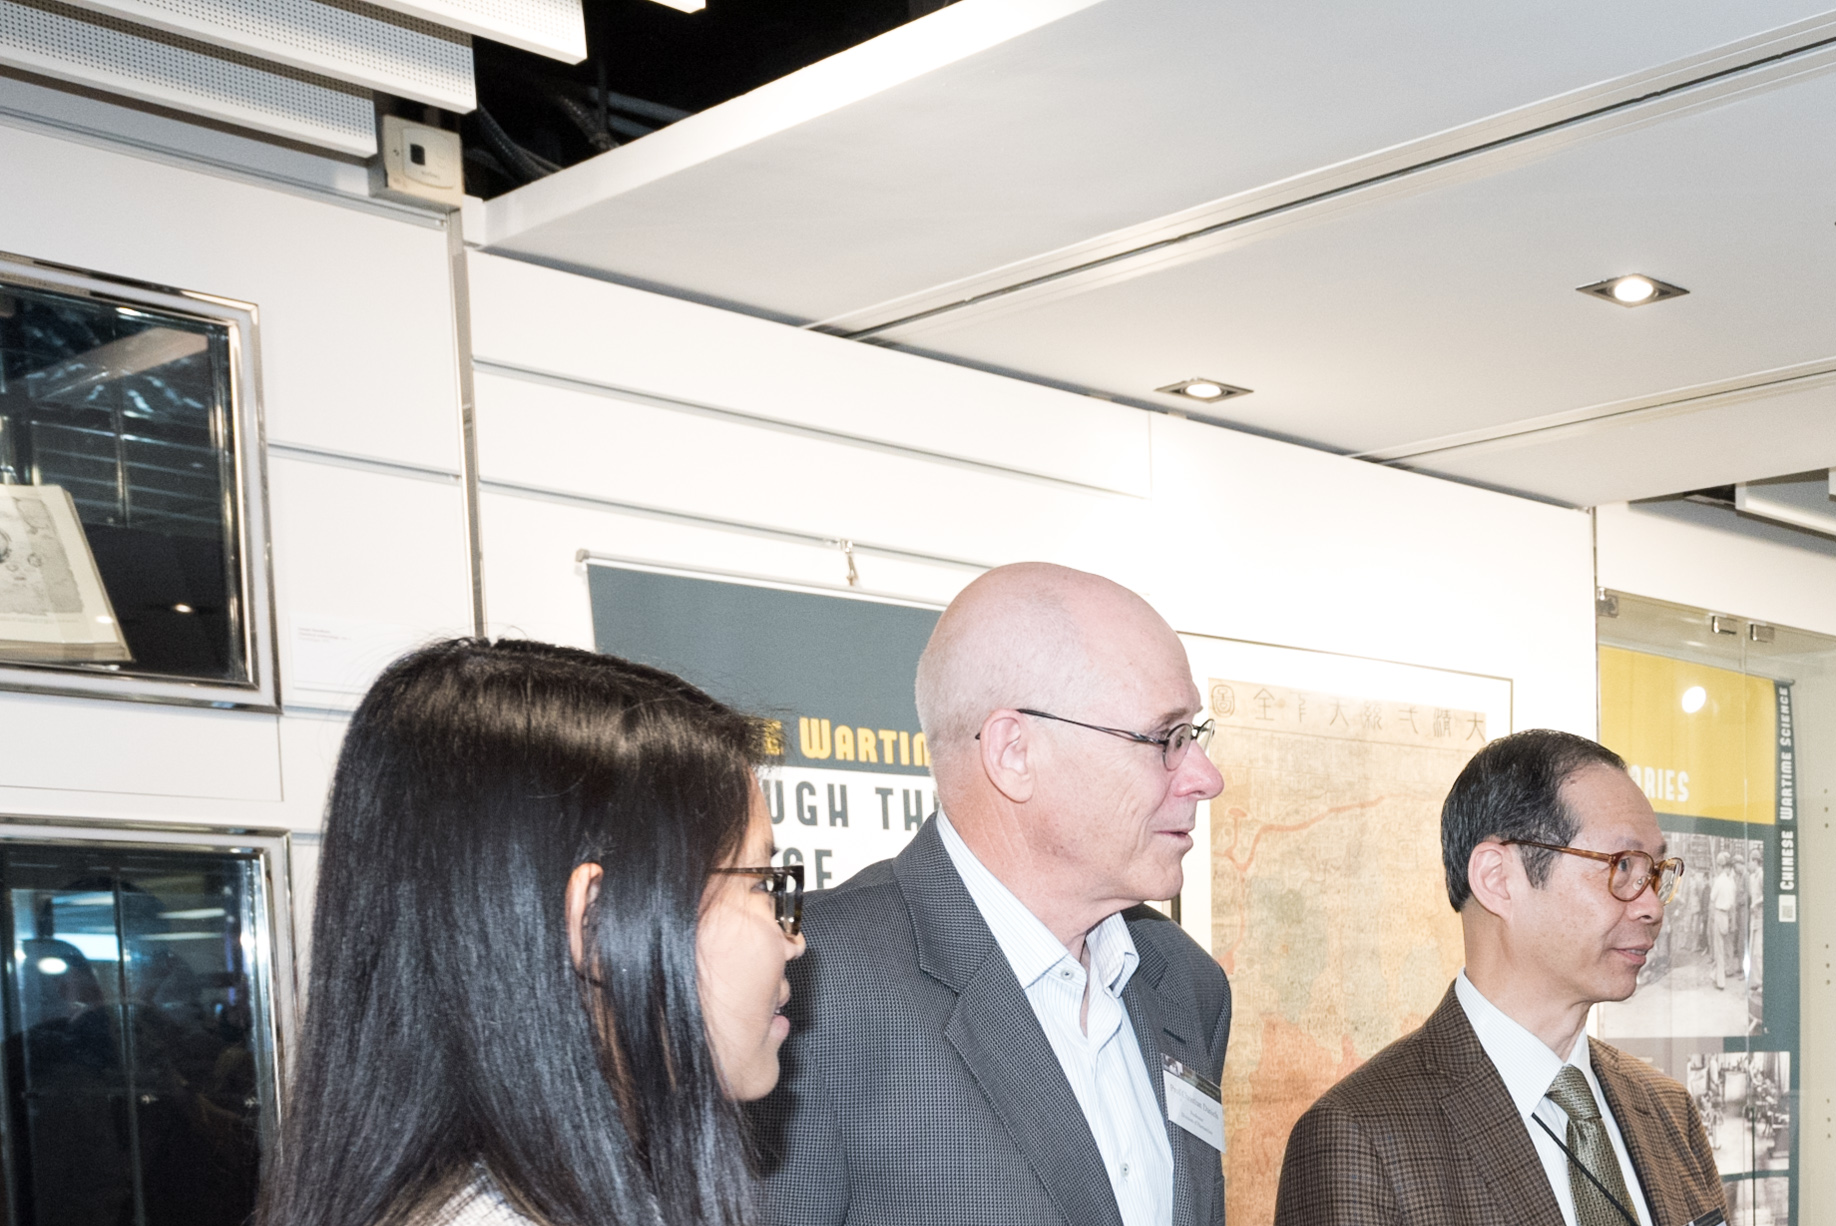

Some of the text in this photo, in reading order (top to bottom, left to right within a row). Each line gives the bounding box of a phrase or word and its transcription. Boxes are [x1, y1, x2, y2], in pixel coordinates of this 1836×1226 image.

[875, 787, 939, 831] TH
[1779, 686, 1794, 890] CHINESE WARTIME SCIENCE
